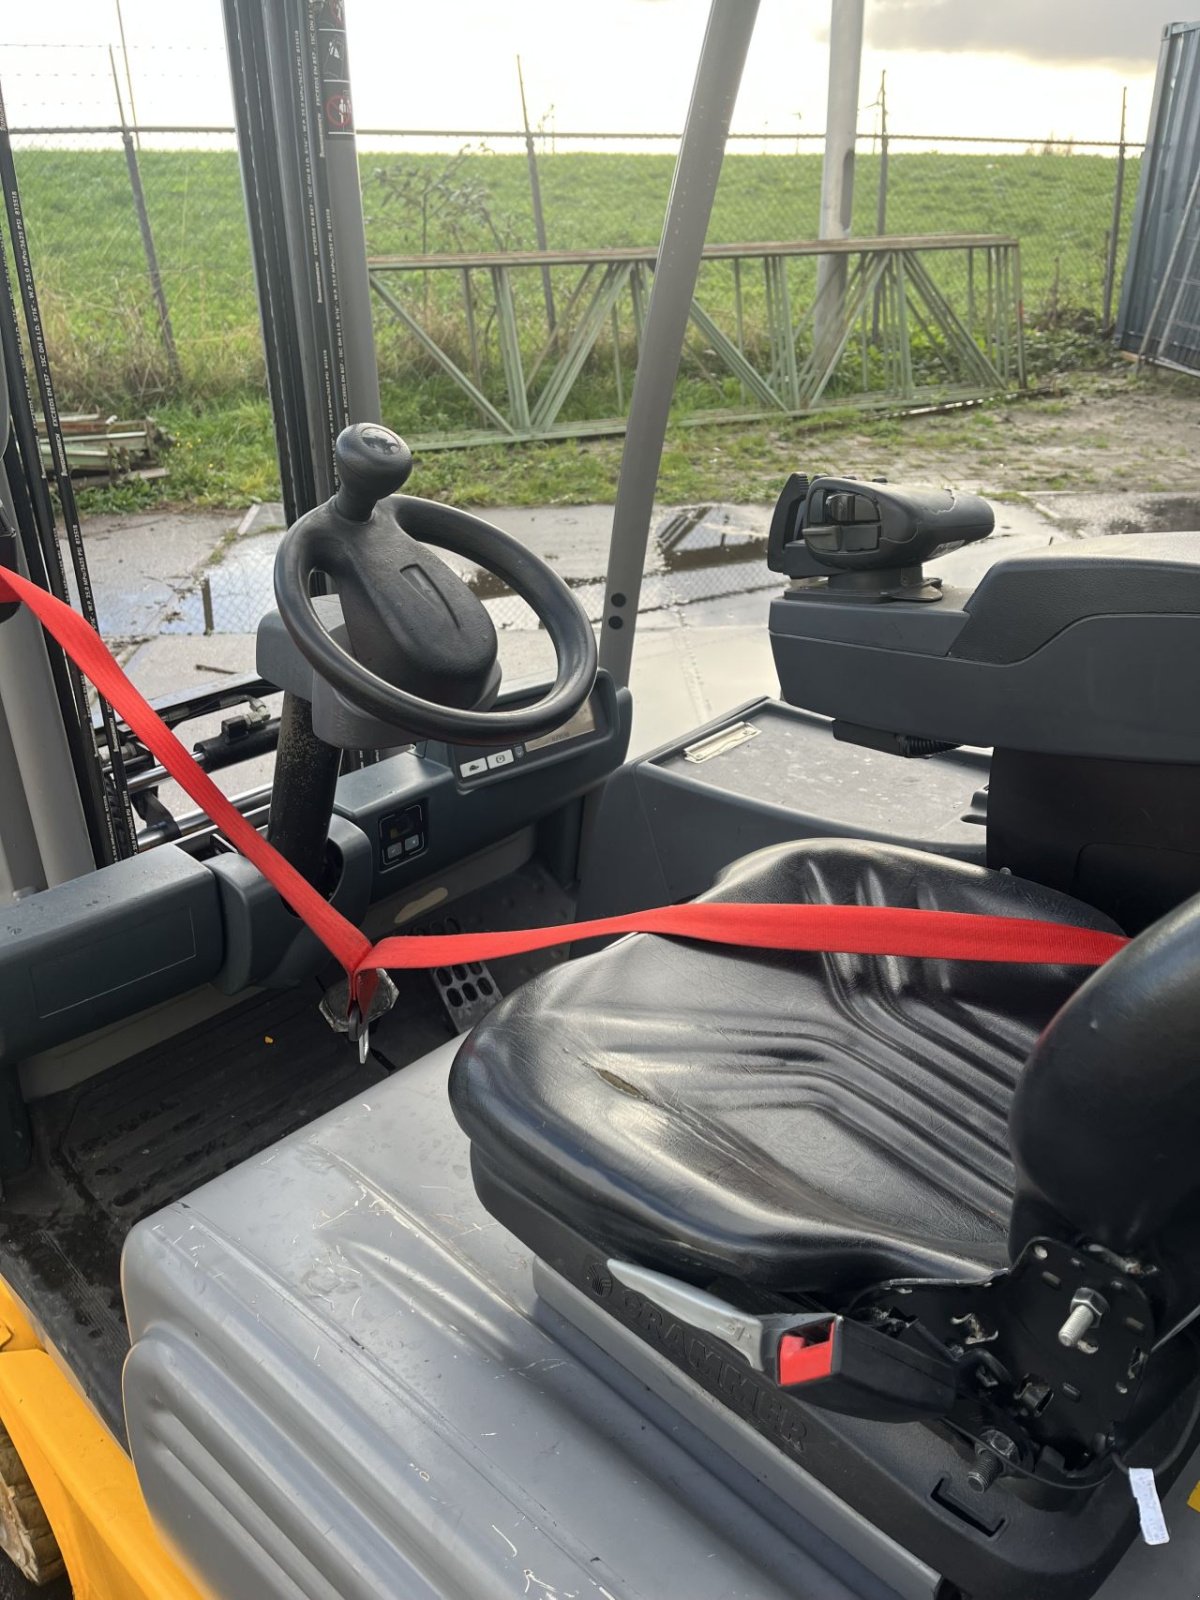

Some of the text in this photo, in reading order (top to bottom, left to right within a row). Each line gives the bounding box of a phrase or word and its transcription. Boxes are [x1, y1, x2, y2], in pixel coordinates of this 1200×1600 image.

[12, 191, 20, 215] 813518
[24, 268, 32, 282] 25.0
[38, 342, 44, 353] DN
[46, 387, 53, 397] EN
[48, 398, 58, 427] EXCEEDS
